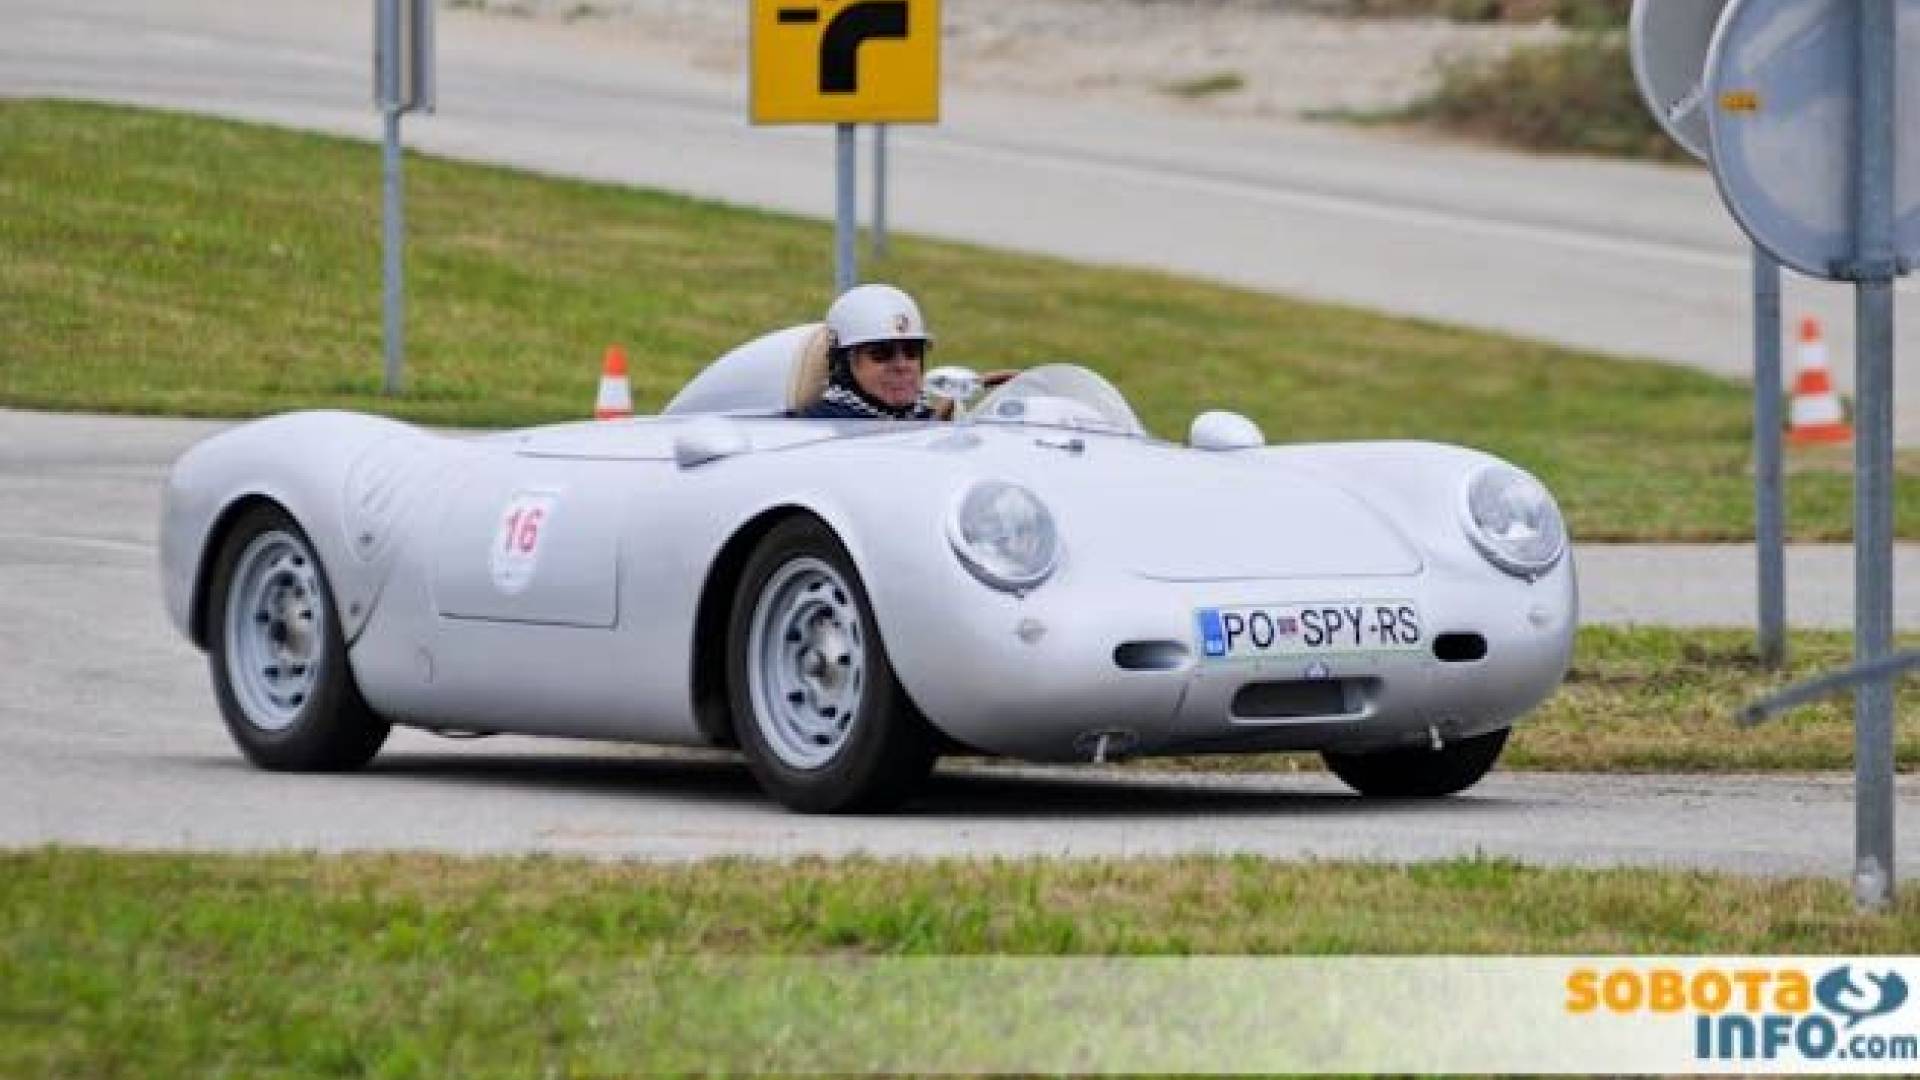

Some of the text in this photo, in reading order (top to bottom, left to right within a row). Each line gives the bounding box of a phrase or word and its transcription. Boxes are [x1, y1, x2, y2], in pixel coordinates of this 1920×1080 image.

[504, 508, 545, 553] 16
[1223, 606, 1419, 650] PO SPY-RS
